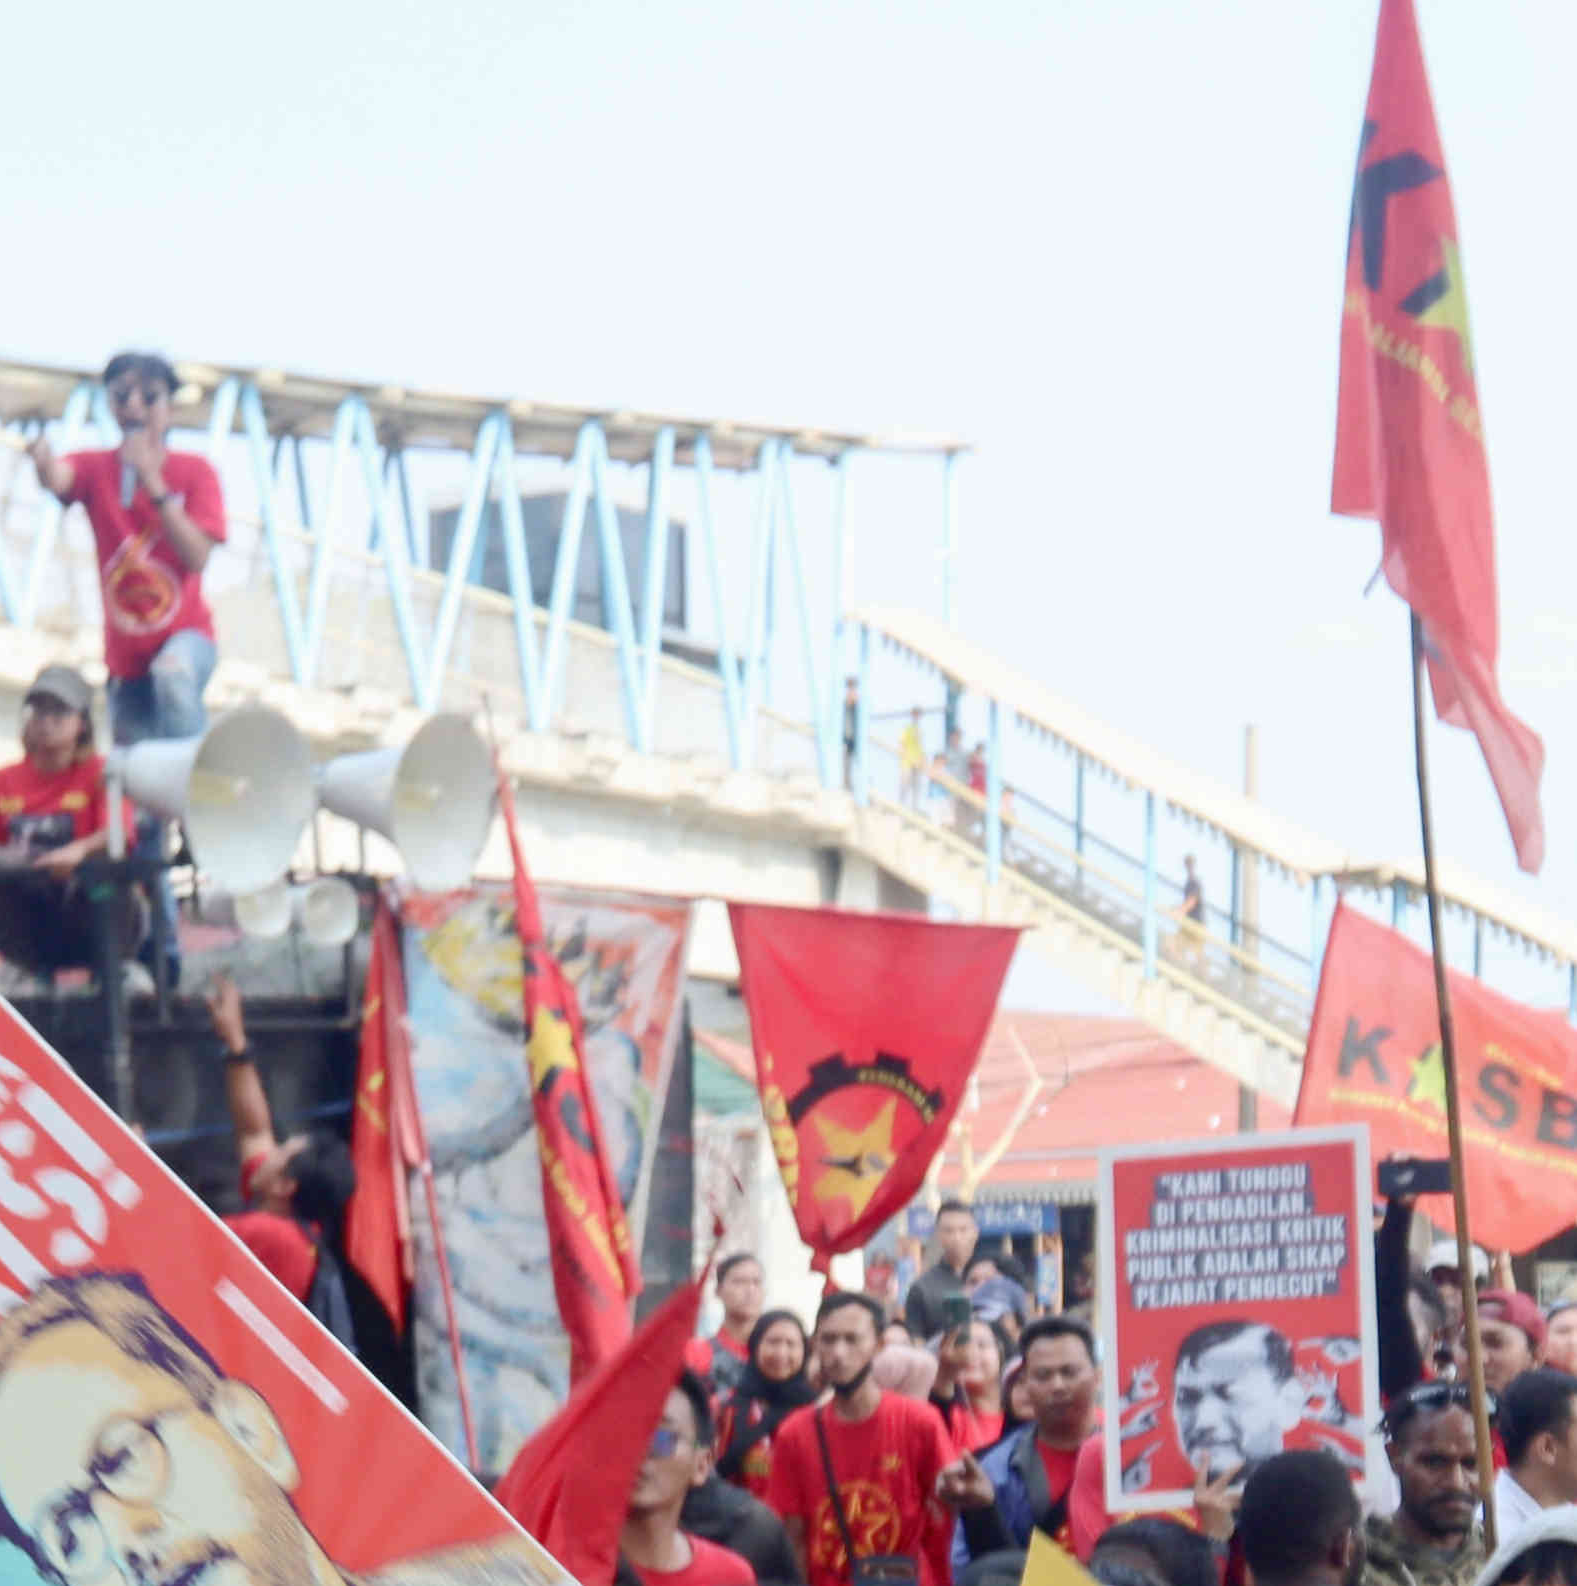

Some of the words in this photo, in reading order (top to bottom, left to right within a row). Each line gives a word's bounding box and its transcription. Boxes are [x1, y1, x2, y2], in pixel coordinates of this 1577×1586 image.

[1226, 1163, 1307, 1193] TUNGGU
[1155, 1201, 1177, 1225] DI
[1126, 1221, 1273, 1255] KRIMINALISASI
[1279, 1214, 1345, 1243] KRITIK
[1127, 1254, 1197, 1285] PUBLIK
[1202, 1247, 1280, 1279] ADALAH
[1285, 1242, 1346, 1272] SIKAP
[1134, 1280, 1217, 1312] PEJABAT
